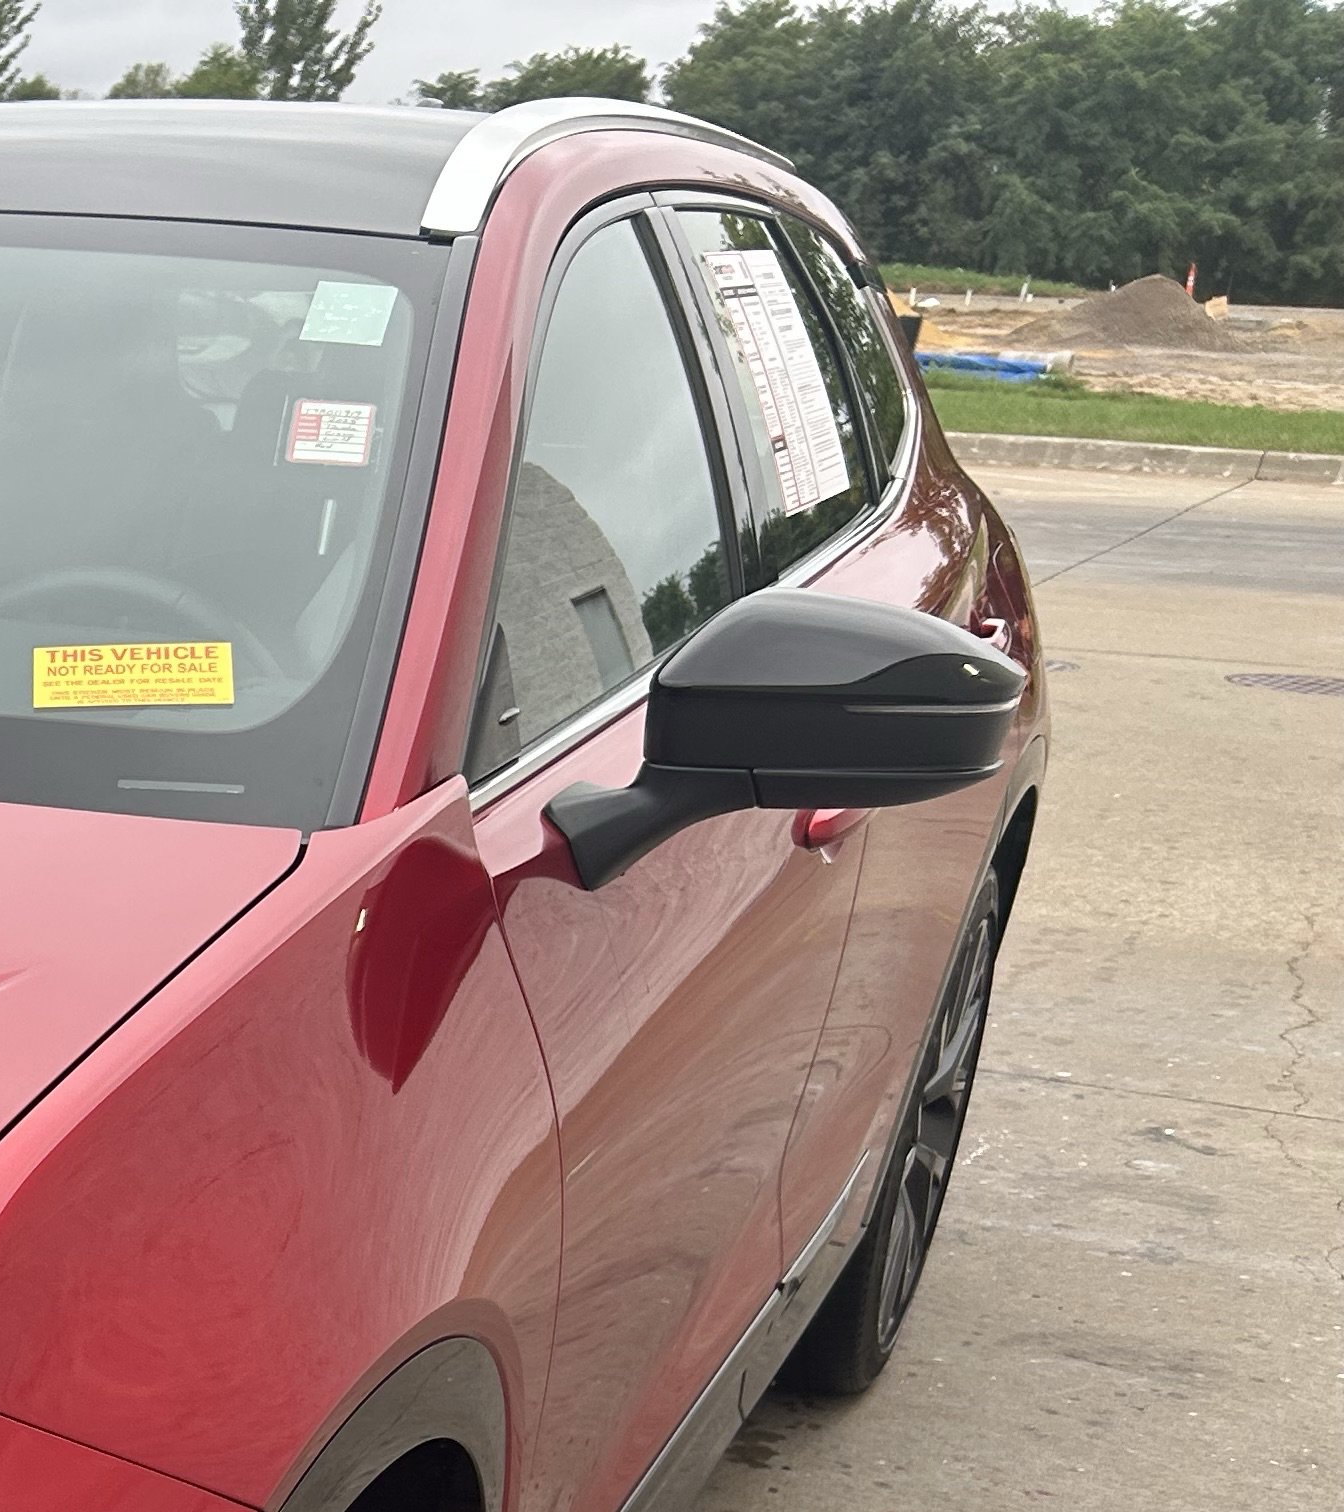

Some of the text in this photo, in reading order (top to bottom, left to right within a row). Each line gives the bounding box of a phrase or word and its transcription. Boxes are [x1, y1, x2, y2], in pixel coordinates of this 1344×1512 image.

[46, 646, 219, 663] THIS VEHICLE
[47, 663, 218, 677] NOT READY FOR SALE
